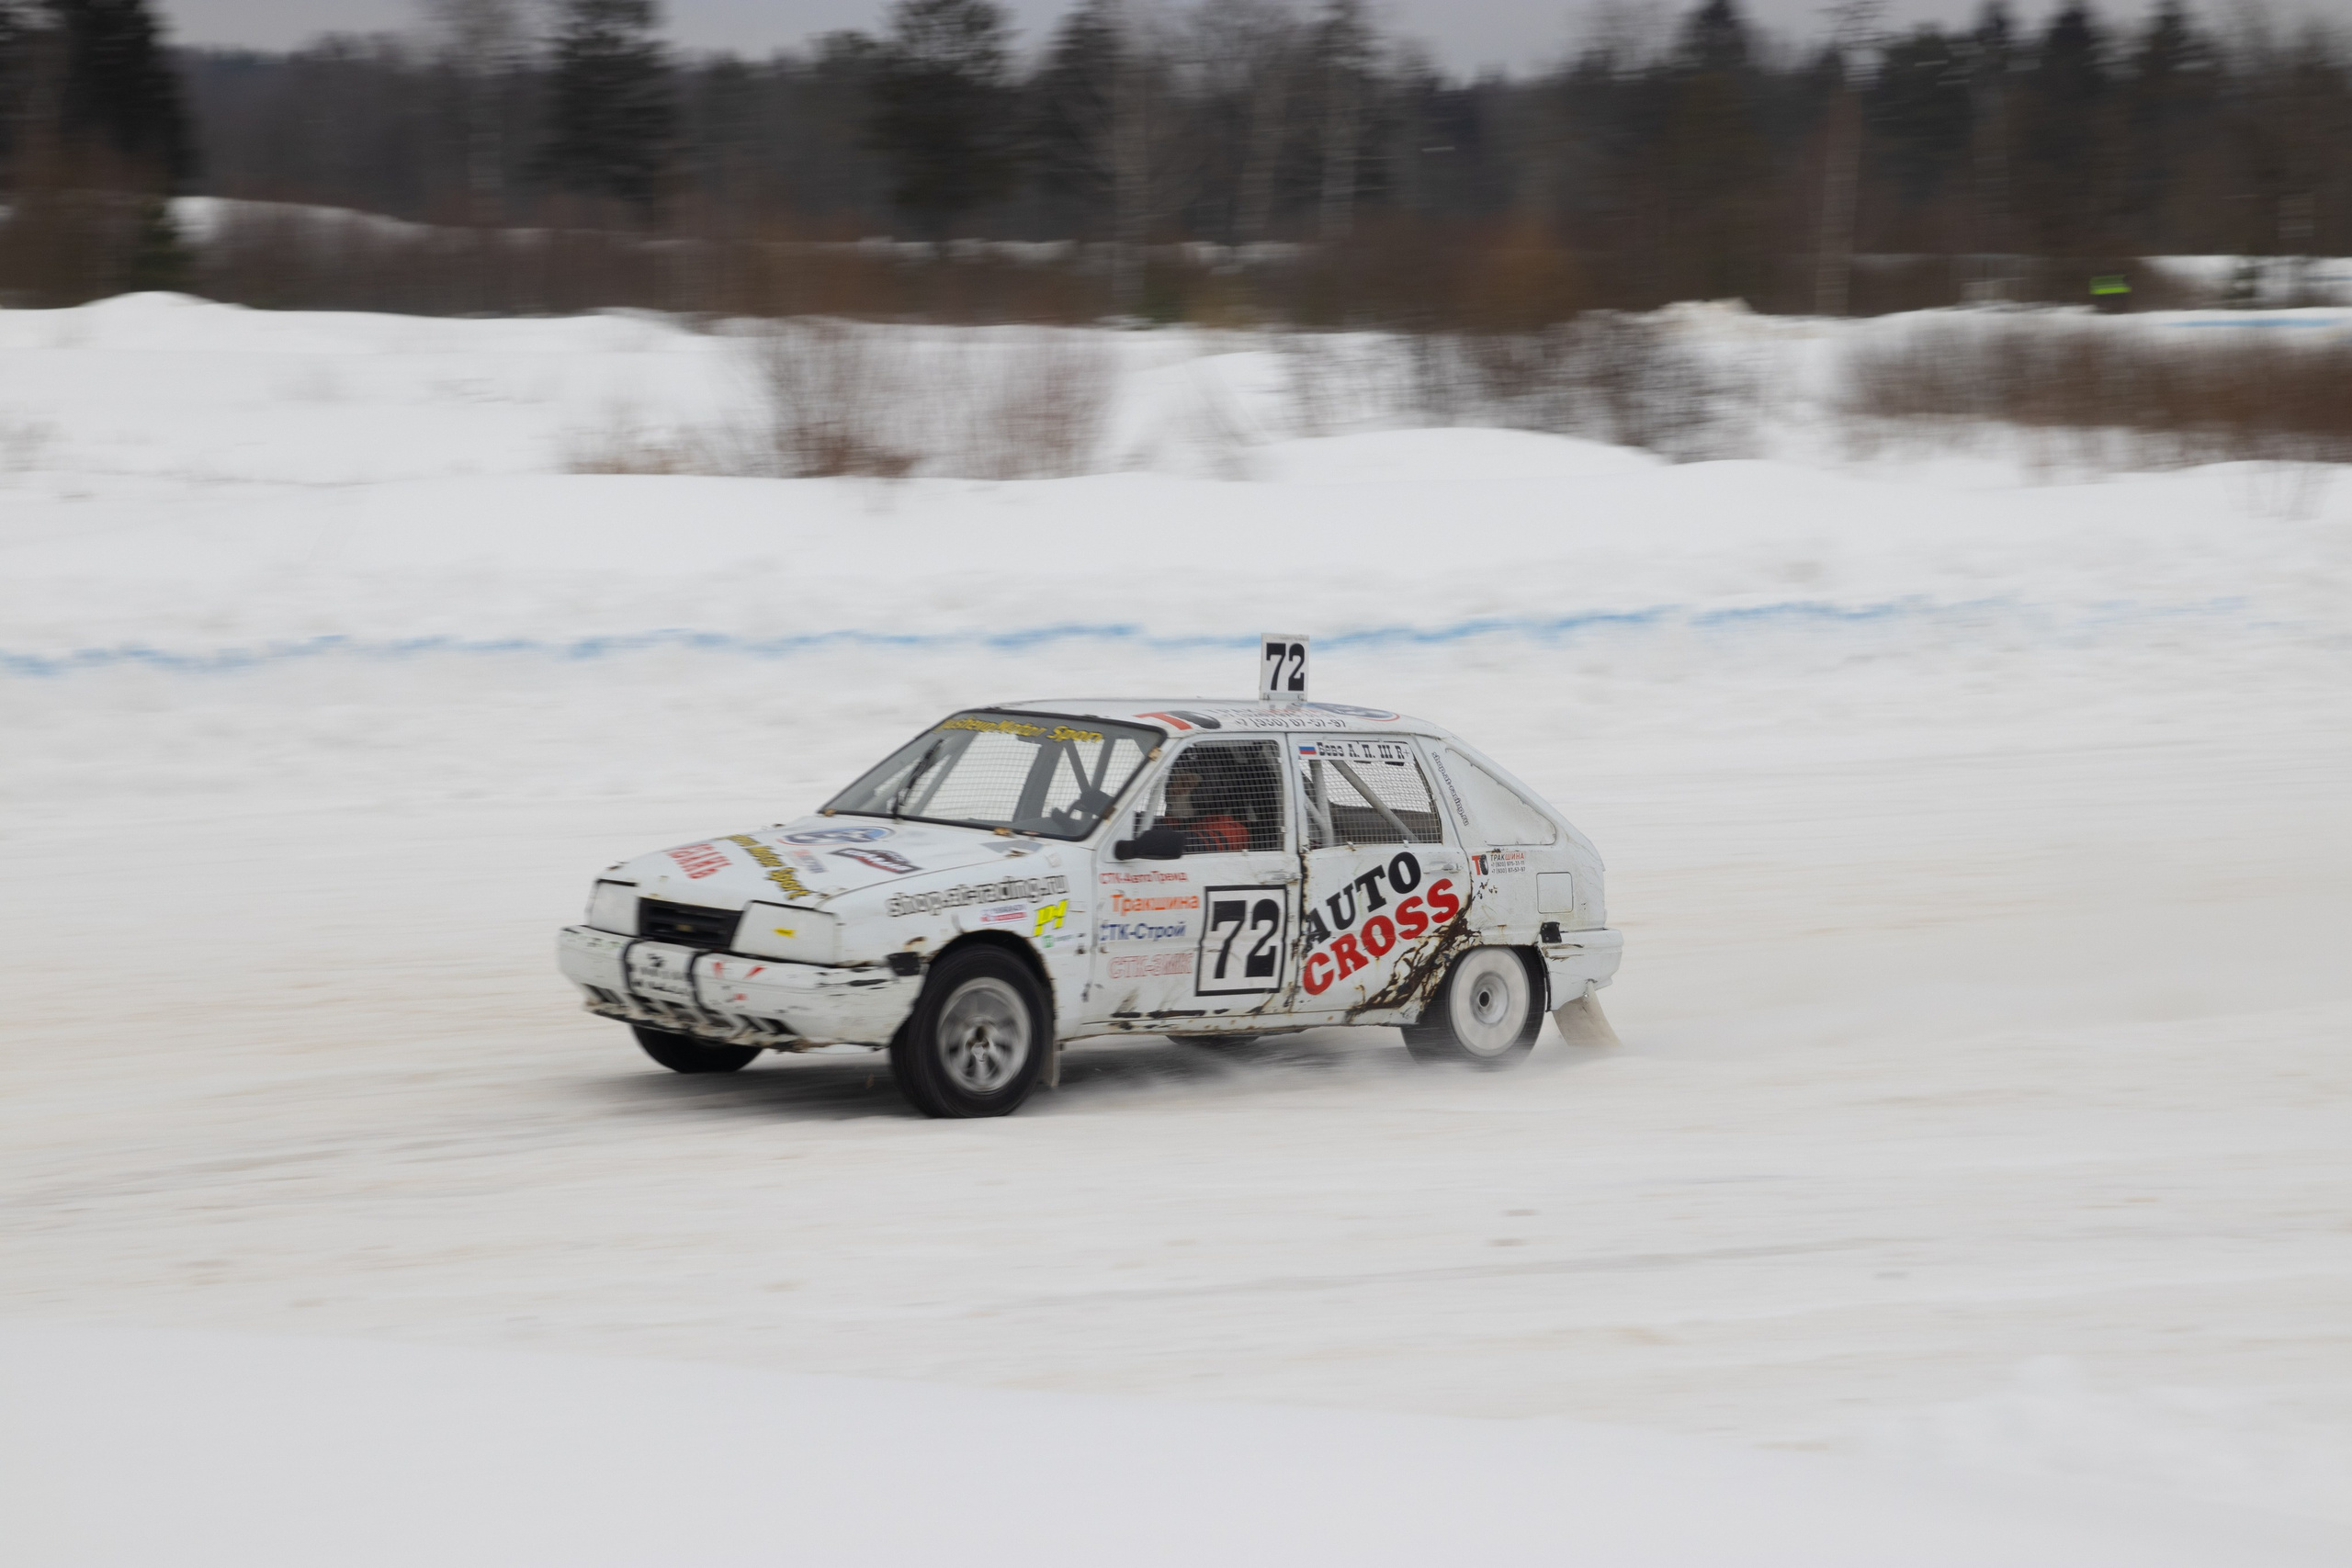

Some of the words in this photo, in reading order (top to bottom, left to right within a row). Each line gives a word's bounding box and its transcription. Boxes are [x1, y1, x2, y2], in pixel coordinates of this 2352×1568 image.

[1266, 642, 1305, 692] 72
[1490, 852, 1524, 862] ТРАКШИНА
[1111, 894, 1200, 917] Тракшина
[1304, 851, 1421, 954] AUTO
[1100, 920, 1186, 942] СТК-Строй
[1211, 898, 1280, 980] 72
[1303, 878, 1459, 996] CROSS
